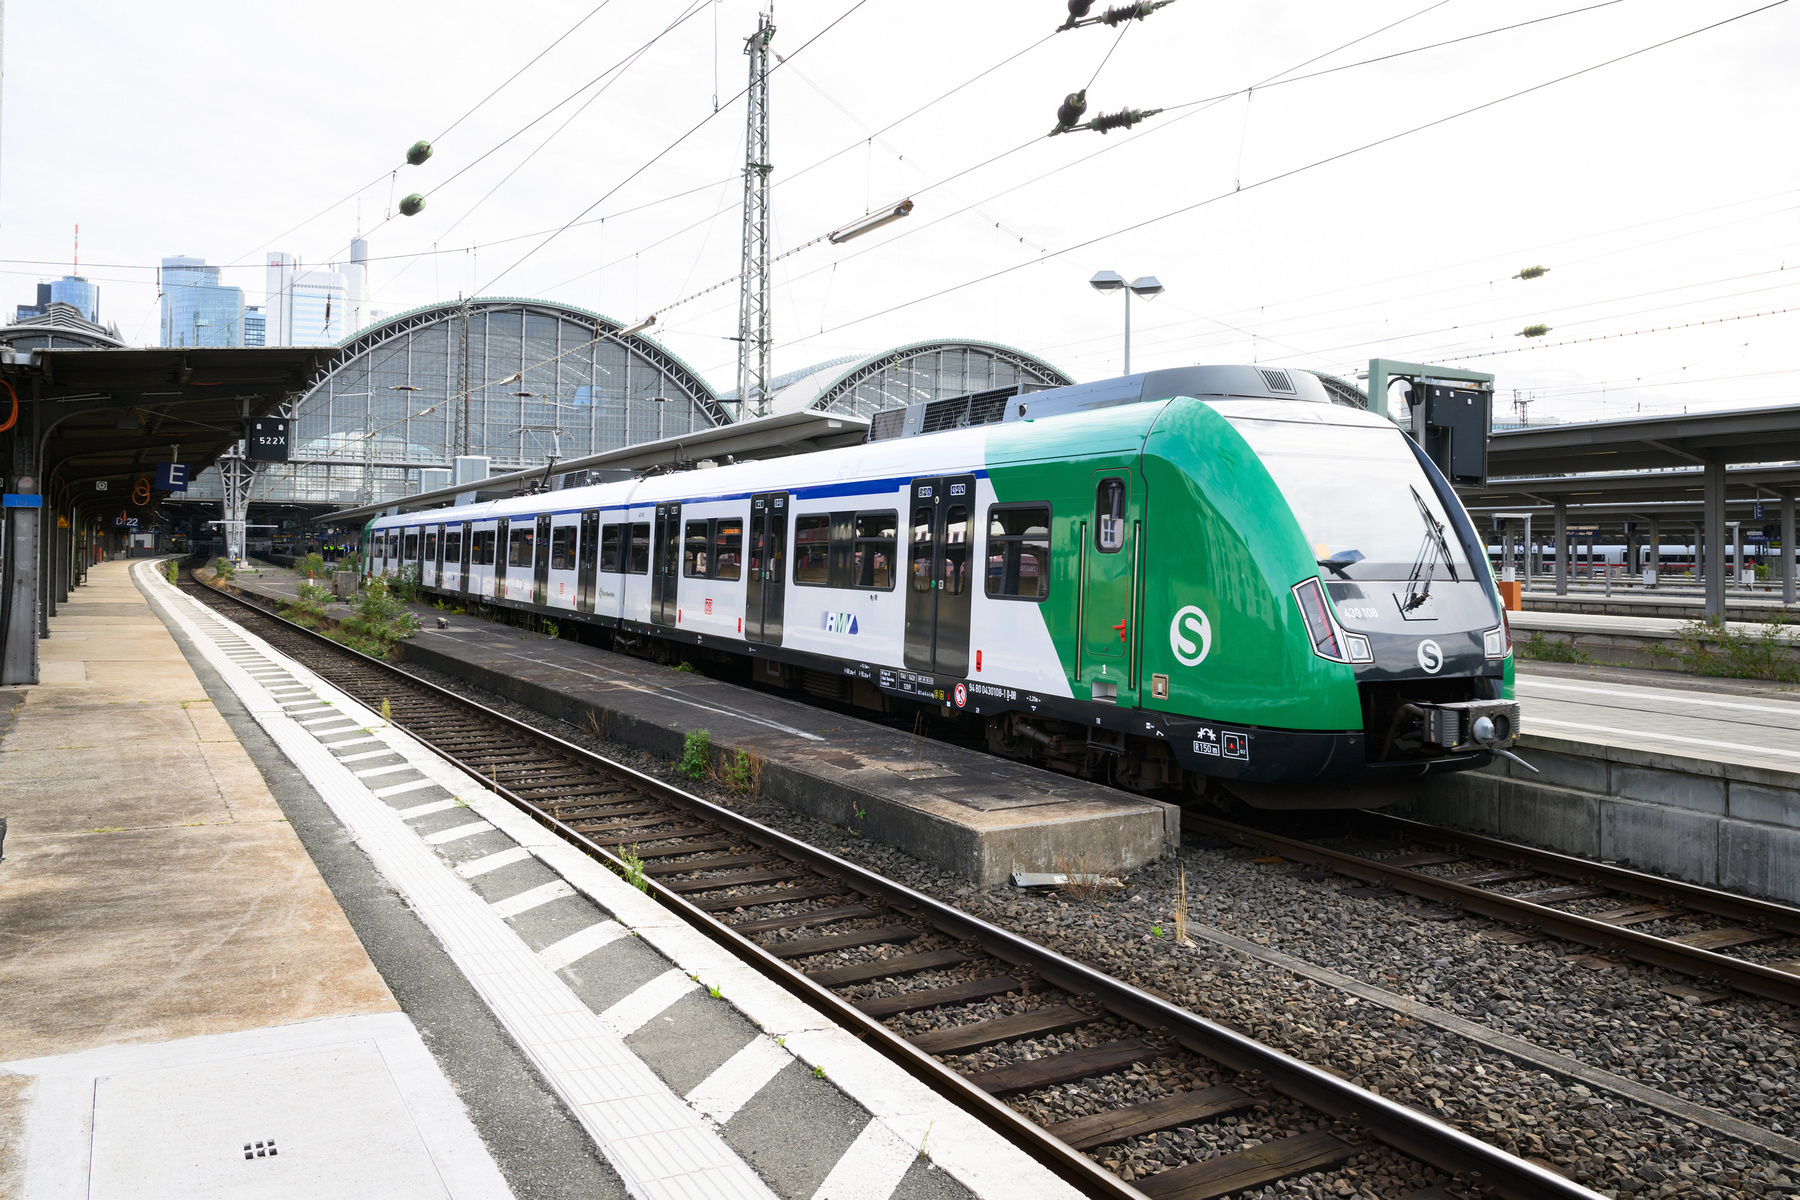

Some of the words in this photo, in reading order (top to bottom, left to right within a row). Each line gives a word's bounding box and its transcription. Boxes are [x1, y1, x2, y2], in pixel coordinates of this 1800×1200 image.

[259, 436, 286, 445] 522X
[169, 463, 186, 485] E
[1757, 505, 1762, 517] E
[126, 517, 138, 527] 22
[1344, 607, 1362, 618] 430
[1362, 607, 1379, 618] 108
[825, 611, 855, 634] RMV
[1176, 610, 1206, 662] S
[1421, 642, 1441, 671] S
[1102, 664, 1107, 674] 1
